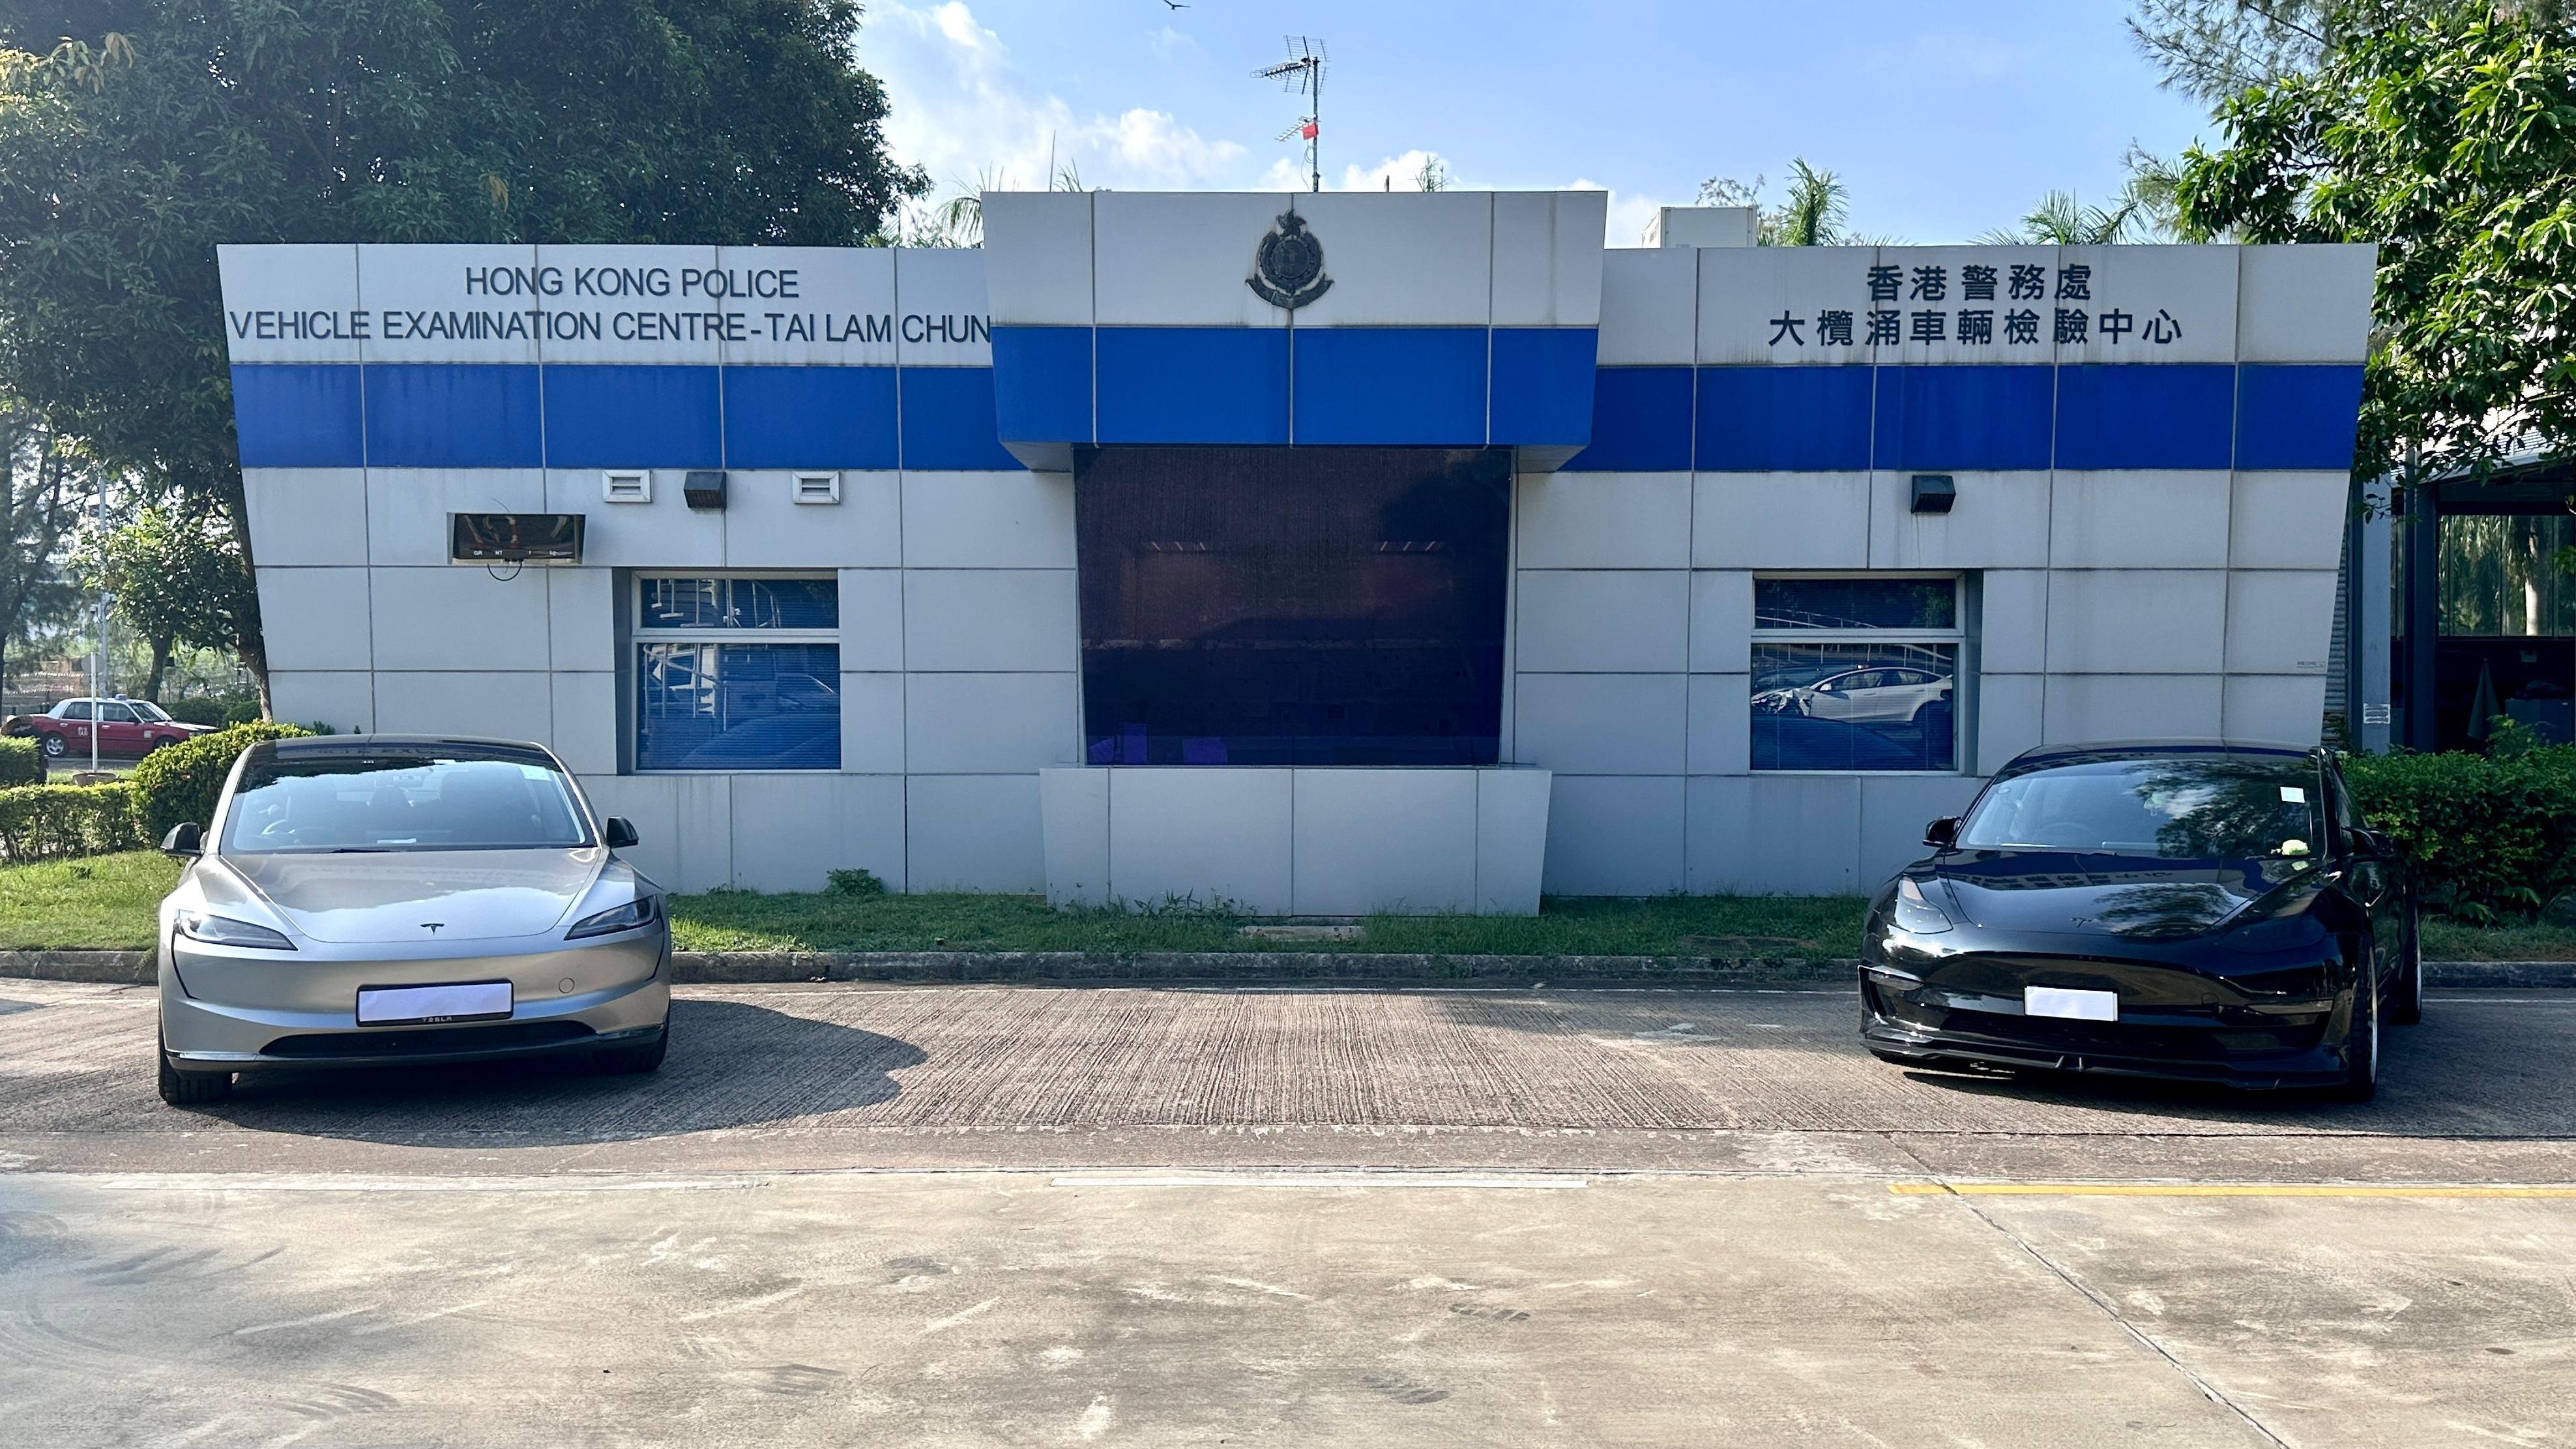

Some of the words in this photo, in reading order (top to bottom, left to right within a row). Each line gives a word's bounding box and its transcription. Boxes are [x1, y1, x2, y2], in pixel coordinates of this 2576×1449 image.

[466, 267, 563, 296] HONG
[575, 267, 670, 297] KONG
[682, 269, 799, 298] POLICE
[1867, 263, 2092, 301] 香港警務處
[229, 310, 371, 340] VEHICLE
[383, 311, 601, 340] EXAMINATION
[826, 314, 891, 343] LAM
[1768, 308, 2182, 346] 大欖涌車輛檢驗中心
